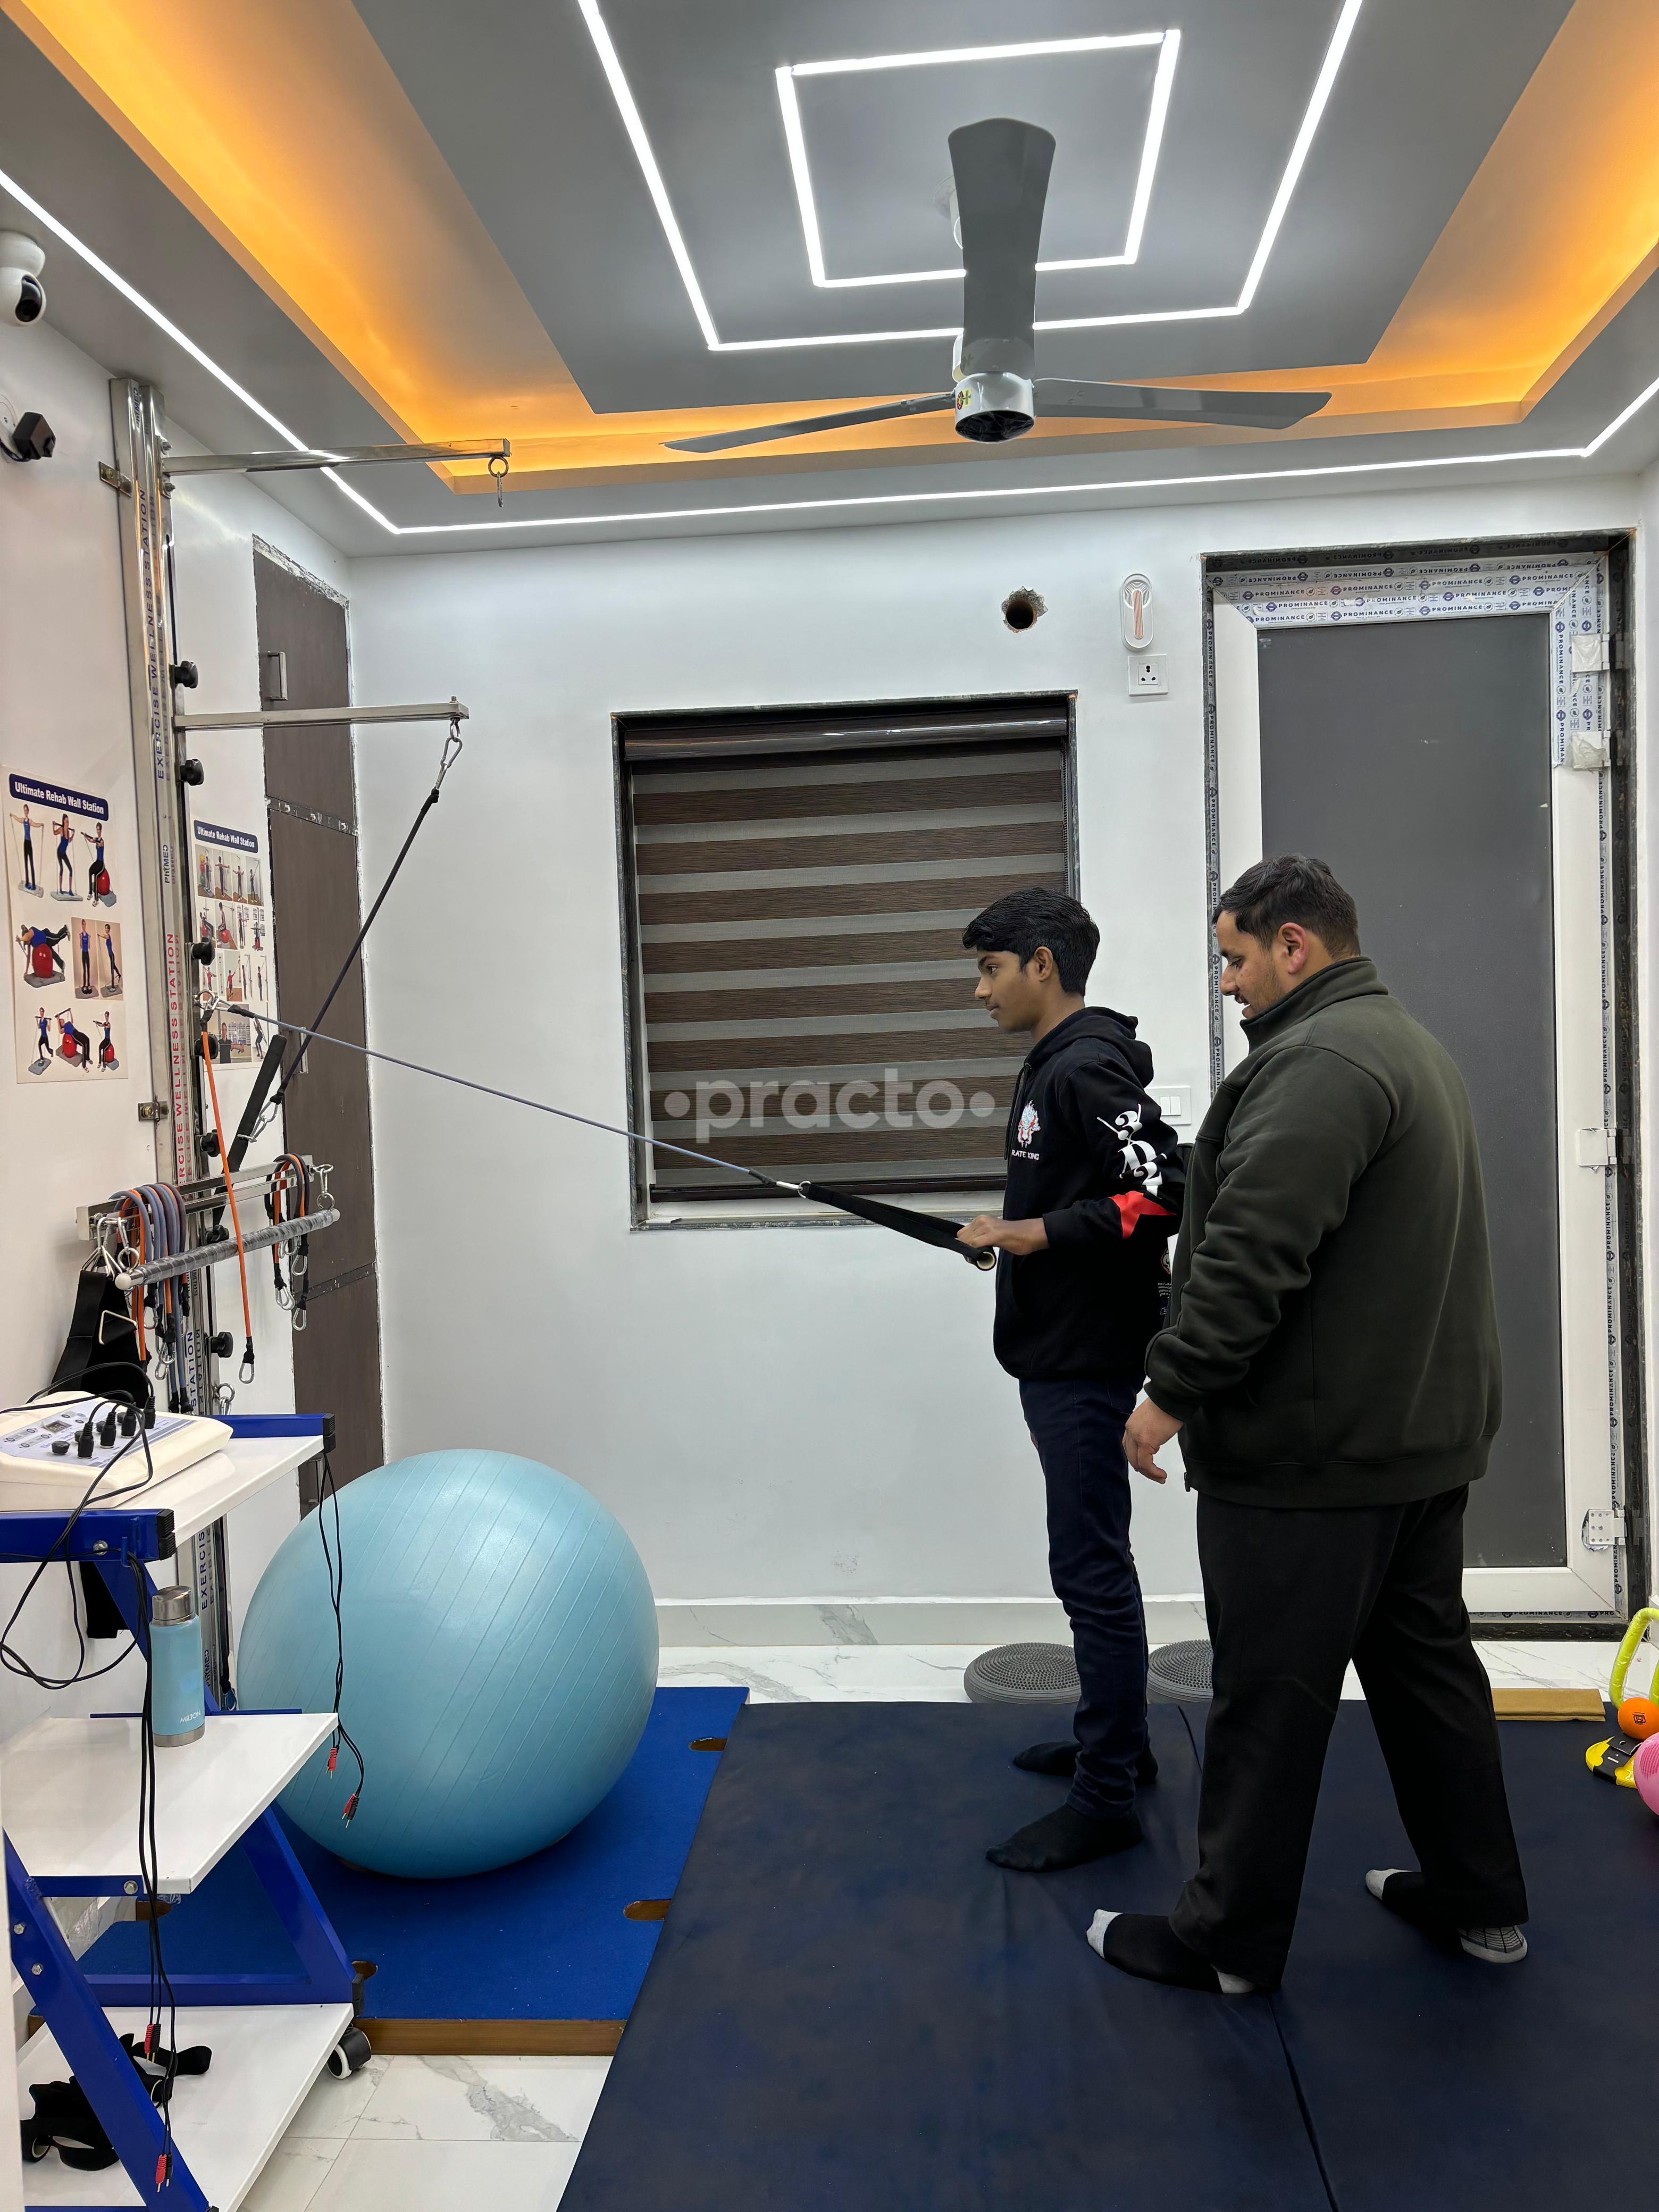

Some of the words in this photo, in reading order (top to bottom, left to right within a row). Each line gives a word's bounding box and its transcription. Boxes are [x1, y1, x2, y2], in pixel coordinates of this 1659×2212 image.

[139, 490, 150, 571] STATION
[1255, 589, 1305, 597] PROMINANCE
[1343, 583, 1393, 592] PROMINANCE
[1432, 578, 1483, 587] PROMINANCE
[1522, 573, 1573, 581] PROMINANCE
[145, 577, 157, 679] WELLNESS
[153, 686, 164, 779] EXERCISE
[14, 781, 45, 799] Ultimate
[46, 790, 66, 805] Rehab
[67, 795, 81, 809] Wall
[82, 799, 104, 815] Station
[197, 826, 215, 839] Ultimate
[216, 831, 230, 843] Rehab
[230, 834, 239, 844] Wall
[240, 836, 255, 848] Station
[166, 934, 178, 1011] STATION
[171, 1017, 182, 1117] WELLNESS
[177, 1122, 186, 1179] RCISE
[1027, 1152, 1040, 1160] KING
[187, 1331, 197, 1407] STATION
[180, 1710, 201, 1723] MILTON
